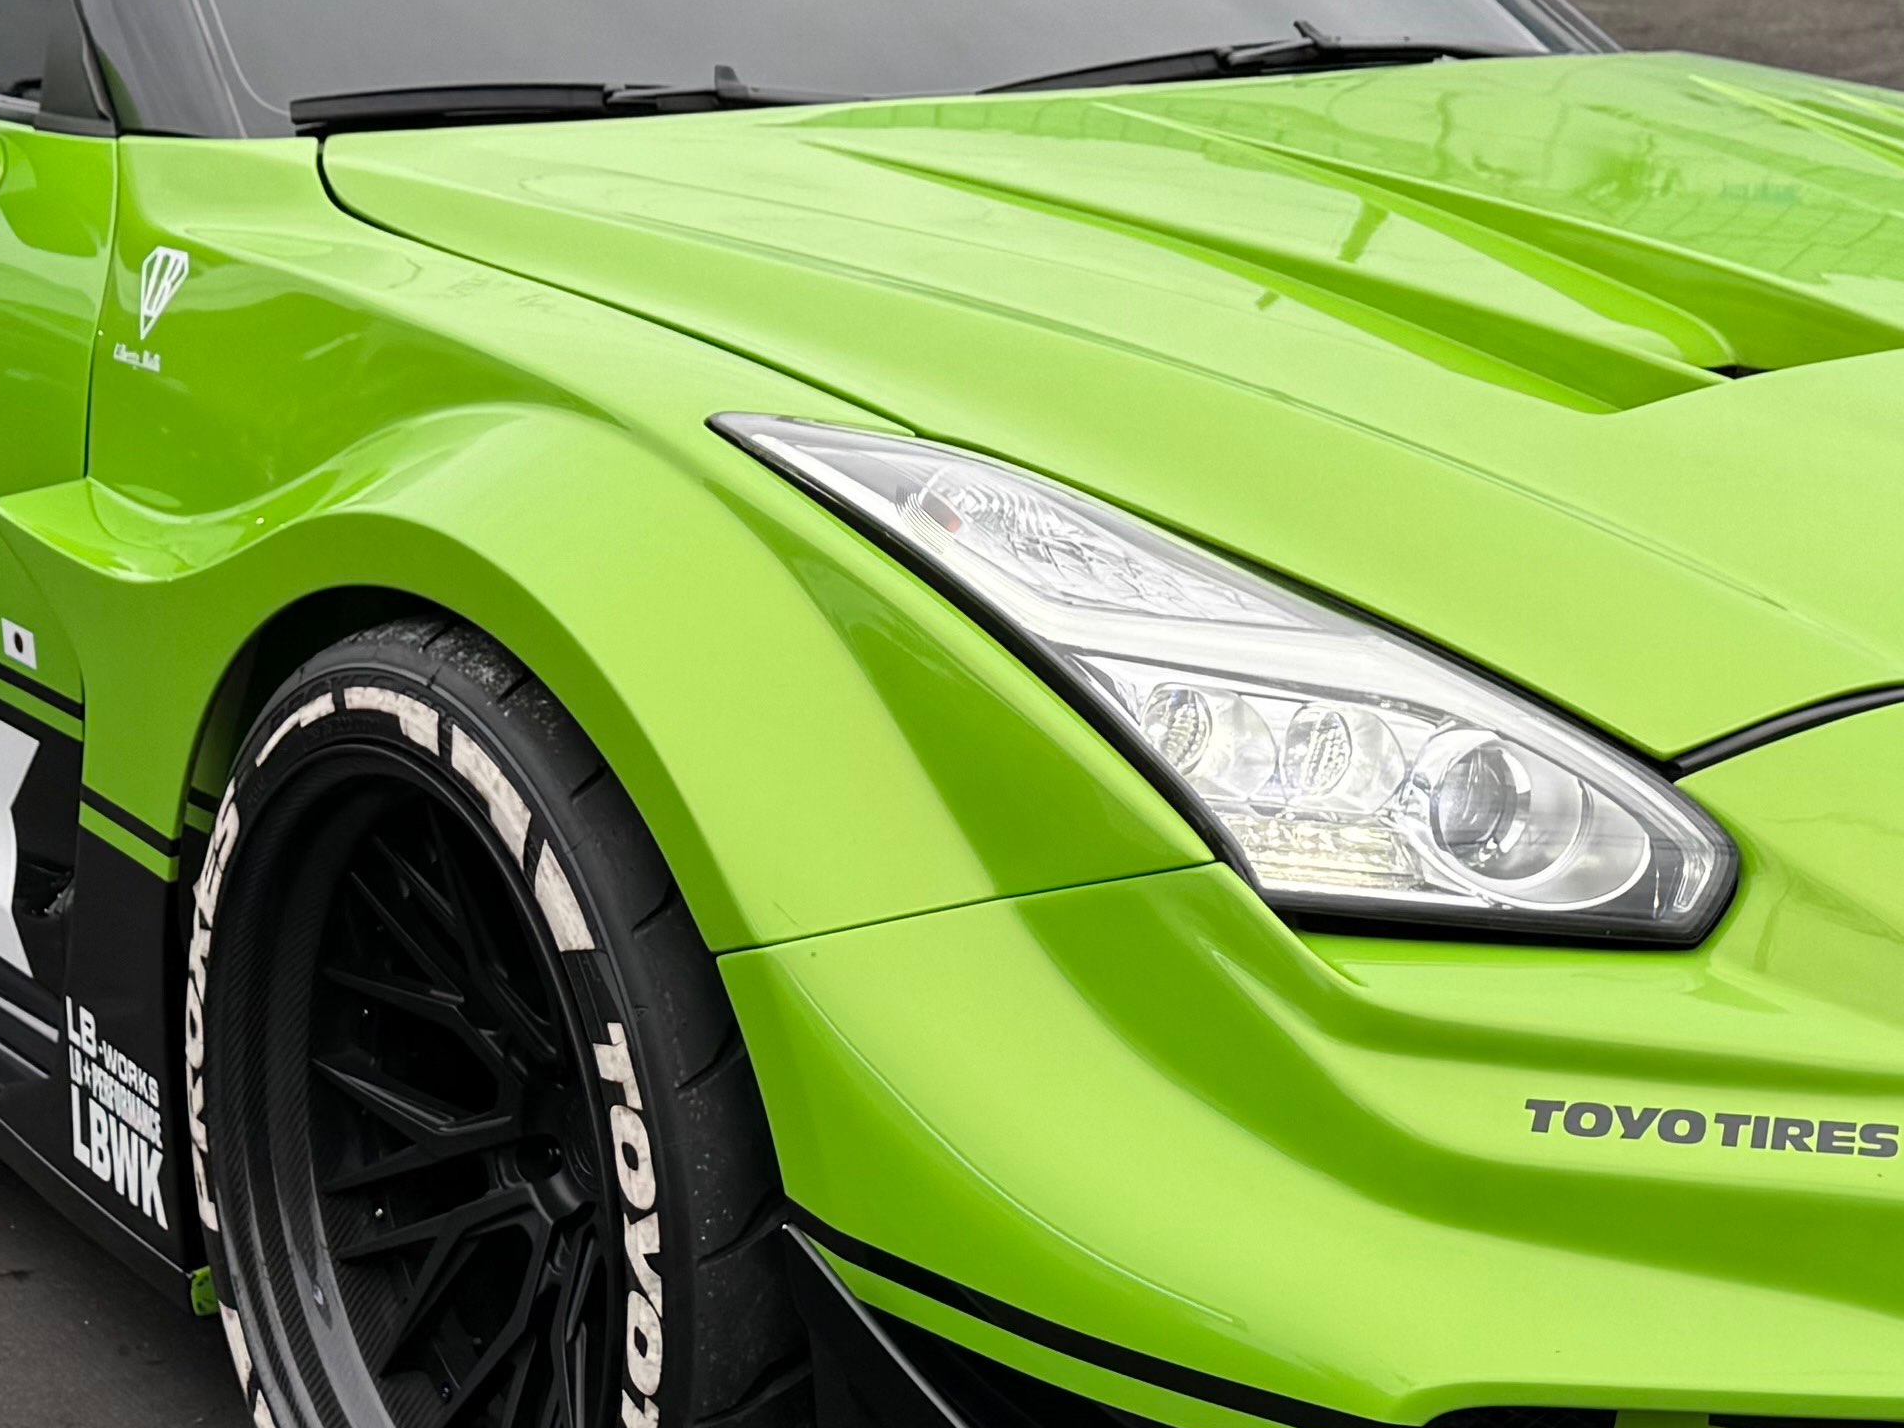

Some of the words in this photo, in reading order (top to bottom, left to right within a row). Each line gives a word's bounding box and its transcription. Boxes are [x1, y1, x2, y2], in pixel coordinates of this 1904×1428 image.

[70, 1083, 168, 1230] LBWK
[1524, 1098, 1706, 1144] TOYO
[1715, 1112, 1899, 1158] TIRES
[593, 1022, 663, 1397] TOYO
